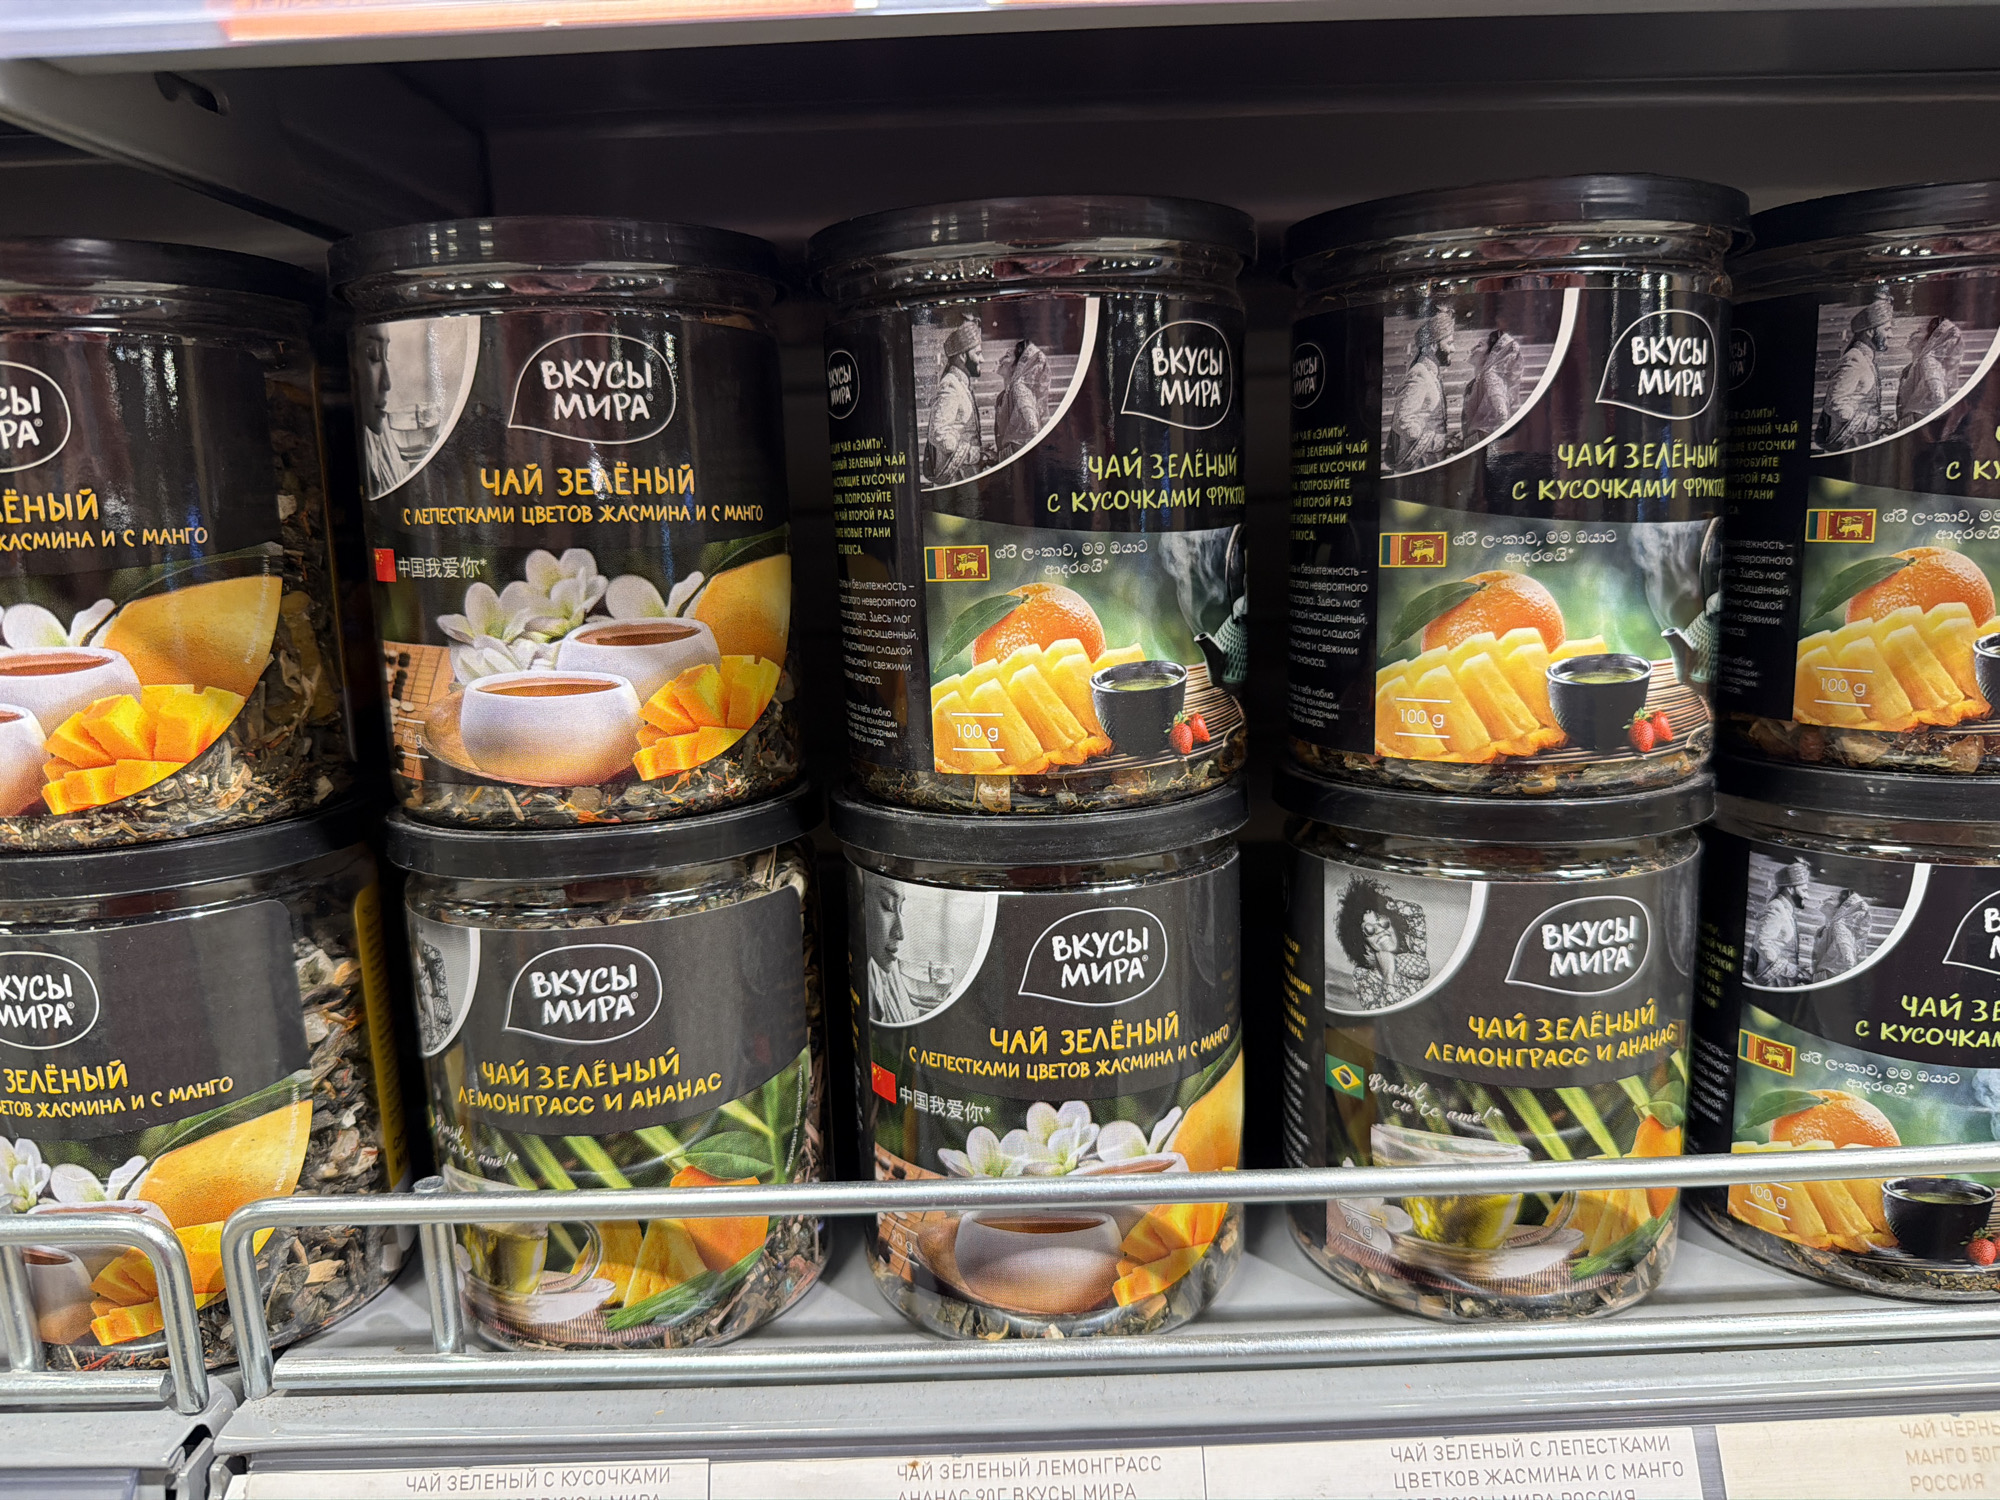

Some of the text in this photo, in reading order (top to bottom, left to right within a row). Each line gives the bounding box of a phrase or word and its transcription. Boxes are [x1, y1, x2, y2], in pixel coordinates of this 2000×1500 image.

[1152, 346, 1223, 376] ВКУСЫ
[1630, 336, 1707, 366] ВКУСЫ
[540, 360, 652, 390] ВКУСЫ
[1774, 420, 1798, 434] ЧАЙ
[884, 452, 906, 466] ЧАЙ
[1306, 442, 1342, 458] ЗЕЛЕНЫЙ
[1345, 440, 1368, 454] ЧАЙ
[1557, 436, 1720, 470] ЧАЙ ЗЕЛЁНЫЙ
[1087, 447, 1237, 480] ЧАЙ ЗЕЛЁНЫЙ
[1319, 460, 1366, 474] КУСОЧКИ
[1946, 461, 1961, 480] С
[480, 464, 695, 499] ЧАЙ ЗЕЛЁНЫЙ
[861, 473, 905, 486] КУСОЧКИ
[1300, 477, 1351, 491] ПОПРОБУЙТЕ
[1761, 472, 1780, 484] РАЗ
[844, 490, 891, 504] ПОПРОБУЙТЕ
[1512, 477, 1677, 501] С КУСОЧКАМИ
[1048, 487, 1201, 513] С КУСОЧКАМИ
[1302, 495, 1332, 508] ВТОРОЙ
[1333, 496, 1352, 507] РАЗ
[403, 505, 763, 526] С ЛЕПЕСТКАМИ ЦВЕТОВ ЖАСМИНА И С МАНГО
[877, 509, 894, 520] РАЗ
[1318, 513, 1347, 524] ГРАНИ
[101, 527, 208, 547] И С МАНГО
[864, 527, 891, 538] ГРАНИ
[1300, 563, 1359, 577] безмятежность
[1765, 571, 1787, 581] мог
[851, 578, 907, 592] безмятежность
[1309, 582, 1368, 594] невероятного
[861, 597, 917, 609] невероятного
[1316, 595, 1362, 608] Здесь мог
[1743, 599, 1784, 611] сладкой
[868, 611, 911, 624] Здесь мог
[1308, 612, 1368, 625] насыщенный,
[862, 628, 919, 641] насыщенный,
[1321, 627, 1361, 640] сладкой
[876, 644, 913, 656] сладкой
[1317, 643, 1358, 655] свежими
[872, 660, 911, 672] свежими
[1820, 676, 1868, 698] 100 g
[1400, 708, 1444, 729] 100 g
[956, 723, 999, 742] 100 g
[1541, 915, 1639, 951] ВКУСЫ
[1052, 926, 1149, 962] ВКУСЫ
[0, 973, 73, 1002] КУСЫ
[530, 963, 638, 998] ВКУСЫ
[1901, 993, 1963, 1021] ЧАЙ
[1468, 997, 1658, 1042] ЧАЙ ЗЕЛЁНЫЙ
[1855, 1019, 1869, 1037] С
[990, 1010, 1180, 1056] ЧАЙ ЗЕЛЁНЫЙ
[909, 1024, 1229, 1081] С ЛЕПЕСТКАМИ ЦВЕТОВ ЖАСМИНА И С МАНГО
[1424, 1041, 1588, 1069] ЛЕМОНГРАСС
[1596, 1044, 1612, 1062] И
[1616, 1022, 1676, 1060] АНАНАС
[3, 1059, 128, 1094] ЗЕЛЁНЫЙ
[481, 1046, 680, 1090] ЧАЙ ЗЕЛЁНЫЙ
[458, 1072, 722, 1117] ЛЕМОНГРАСС И АНАНАС
[1368, 1072, 1428, 1101] Brasil
[36, 1076, 234, 1119] ЖАСМИНА И С МАНГО
[1750, 1183, 1787, 1210] 100 g
[1344, 1214, 1374, 1240] 90 g
[1899, 1418, 1937, 1439] ЧАЙ
[1391, 1435, 1671, 1463] ЧАЙ ЗЕЛЕНЫЙ С ЛЕПЕСТКАМИ
[1905, 1446, 2000, 1466] МАНГО 50Г
[897, 1455, 1162, 1482] ЧАЙ ЗЕЛЕНЫЙ ЛЕМОНГРАСС
[1393, 1461, 1684, 1492] ЦВЕТКОВ ЖАСМИНА И С МАНГО
[406, 1467, 671, 1493] ЧАЙ ЗЕЛЕНЫЙ С КУСОЧКАМИ
[1083, 1482, 1137, 1499] МИРА
[1910, 1472, 1985, 1493] РОССИЯ
